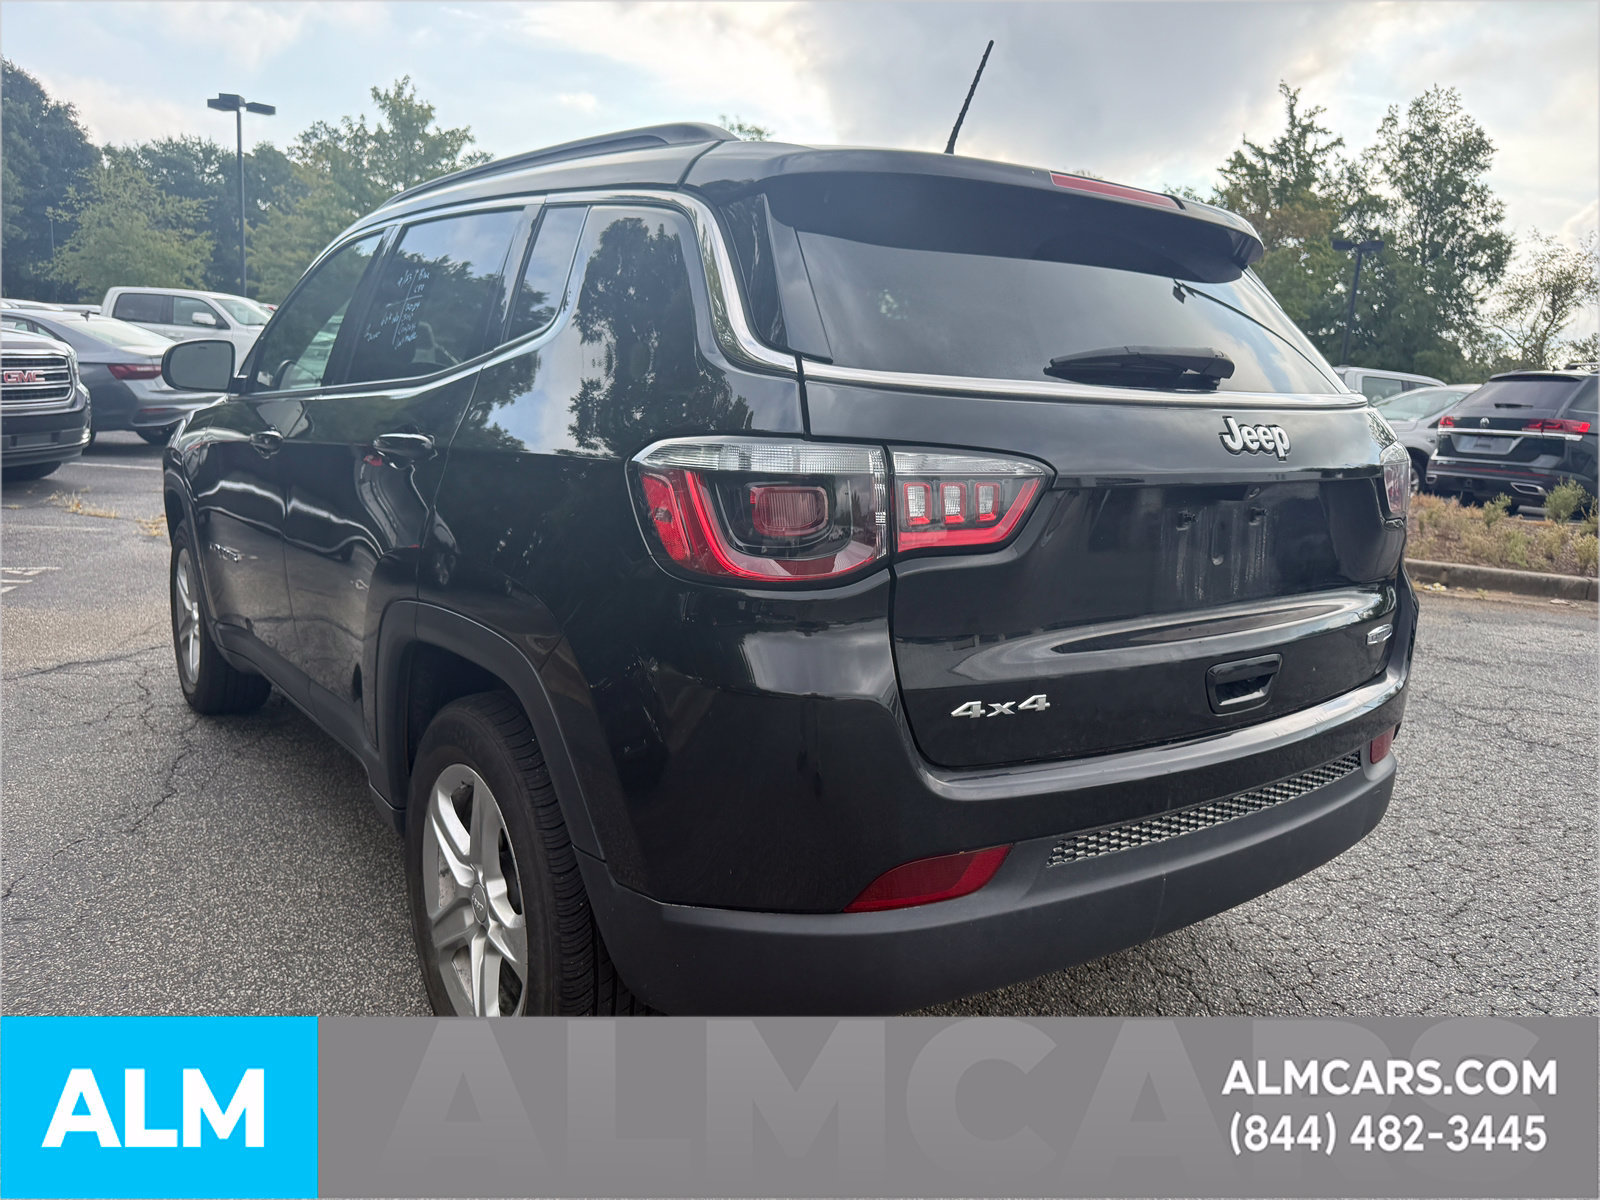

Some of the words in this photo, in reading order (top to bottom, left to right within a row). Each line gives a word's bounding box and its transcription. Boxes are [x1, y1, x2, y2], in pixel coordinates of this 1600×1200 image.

[4, 370, 45, 382] GMC
[1219, 416, 1291, 461] Jeep
[951, 693, 1051, 718] 4x4
